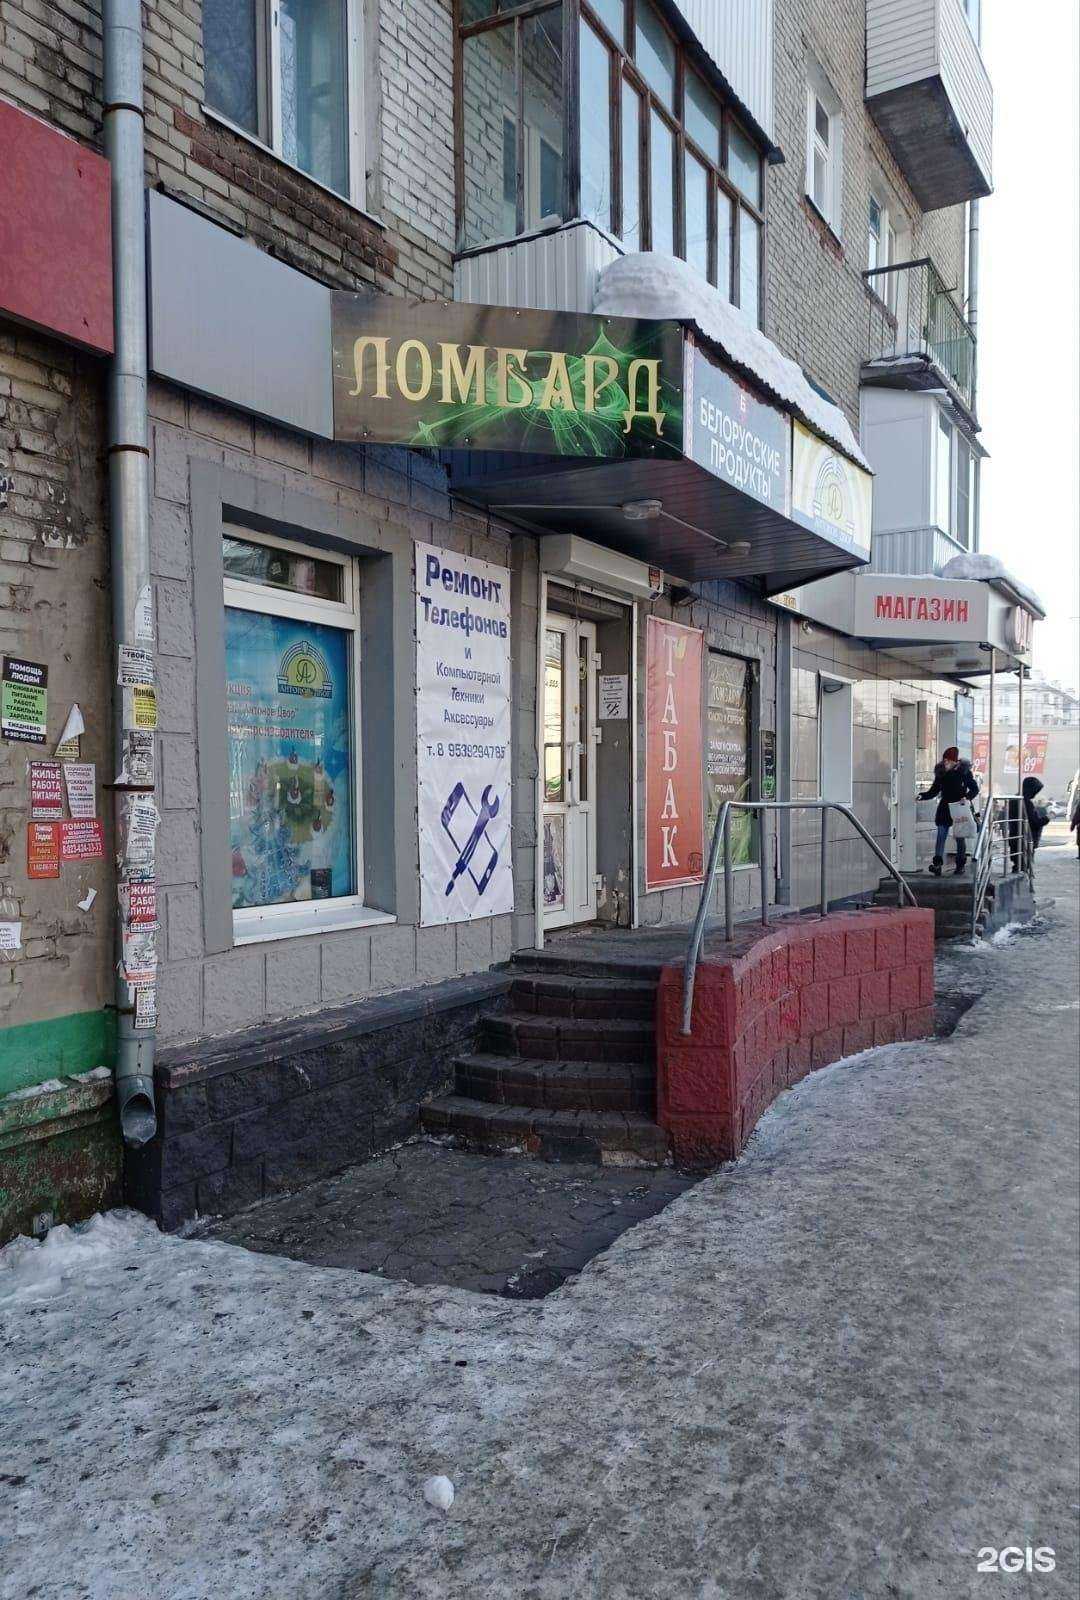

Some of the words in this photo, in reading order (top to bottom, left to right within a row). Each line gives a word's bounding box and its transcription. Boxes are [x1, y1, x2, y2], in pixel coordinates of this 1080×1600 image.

[348, 336, 666, 437] ЛОМБАРД
[700, 396, 781, 476] БЕЛОРУССКИЕ
[710, 437, 772, 500] ПРОДУКТЫ
[425, 554, 502, 603] Ремонт
[875, 595, 969, 622] МАГАЗИН
[420, 596, 508, 639] Телефонов
[464, 647, 472, 660] и
[9, 662, 43, 677] ПОМОЩЬ
[11, 671, 40, 684] ЛЮДЯМ
[436, 661, 501, 686] Компьютерной
[11, 691, 39, 701] ПИТАНИЕ
[13, 698, 36, 707] РАБОТА
[451, 687, 485, 704] Техники
[444, 709, 495, 730] Аксессуары
[447, 743, 506, 759] 9539294785
[660, 634, 680, 870] ТАБАК
[31, 769, 62, 780] ЖИЛЬЕ
[31, 779, 62, 791] РАБОТА
[31, 790, 63, 800] ПИТАНИЕ
[62, 821, 100, 831] ПОМОЩЬ
